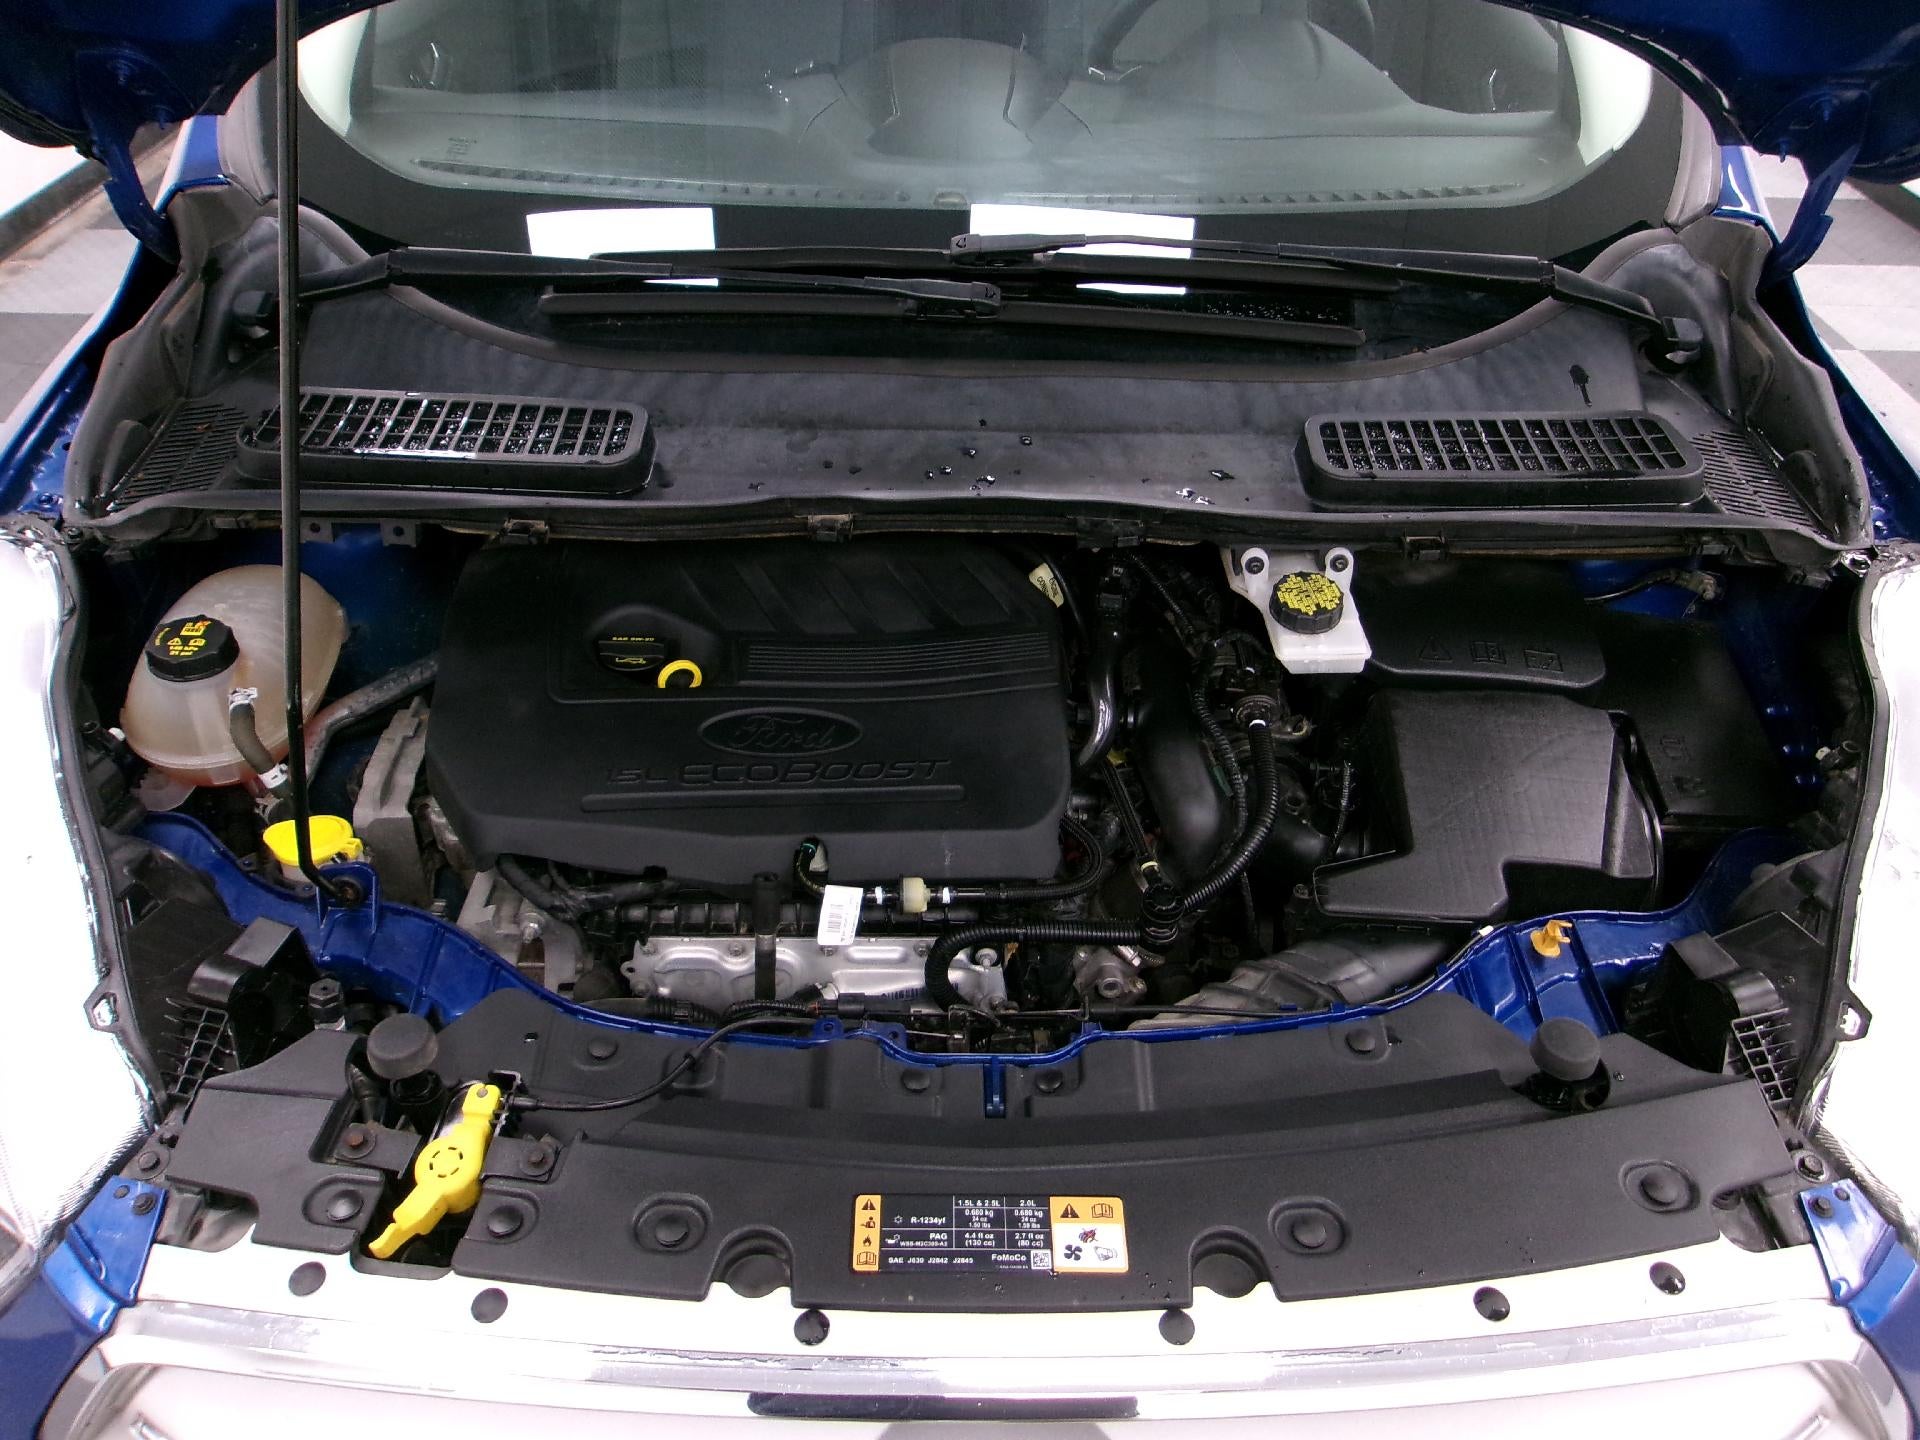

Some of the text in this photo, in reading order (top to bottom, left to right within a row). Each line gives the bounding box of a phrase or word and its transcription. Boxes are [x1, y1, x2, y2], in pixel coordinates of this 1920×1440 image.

[732, 713, 837, 751] Ford
[910, 1216, 946, 1226] R-1234yf
[929, 1232, 948, 1240] PAG
[991, 1253, 1027, 1261] FoMoCo
